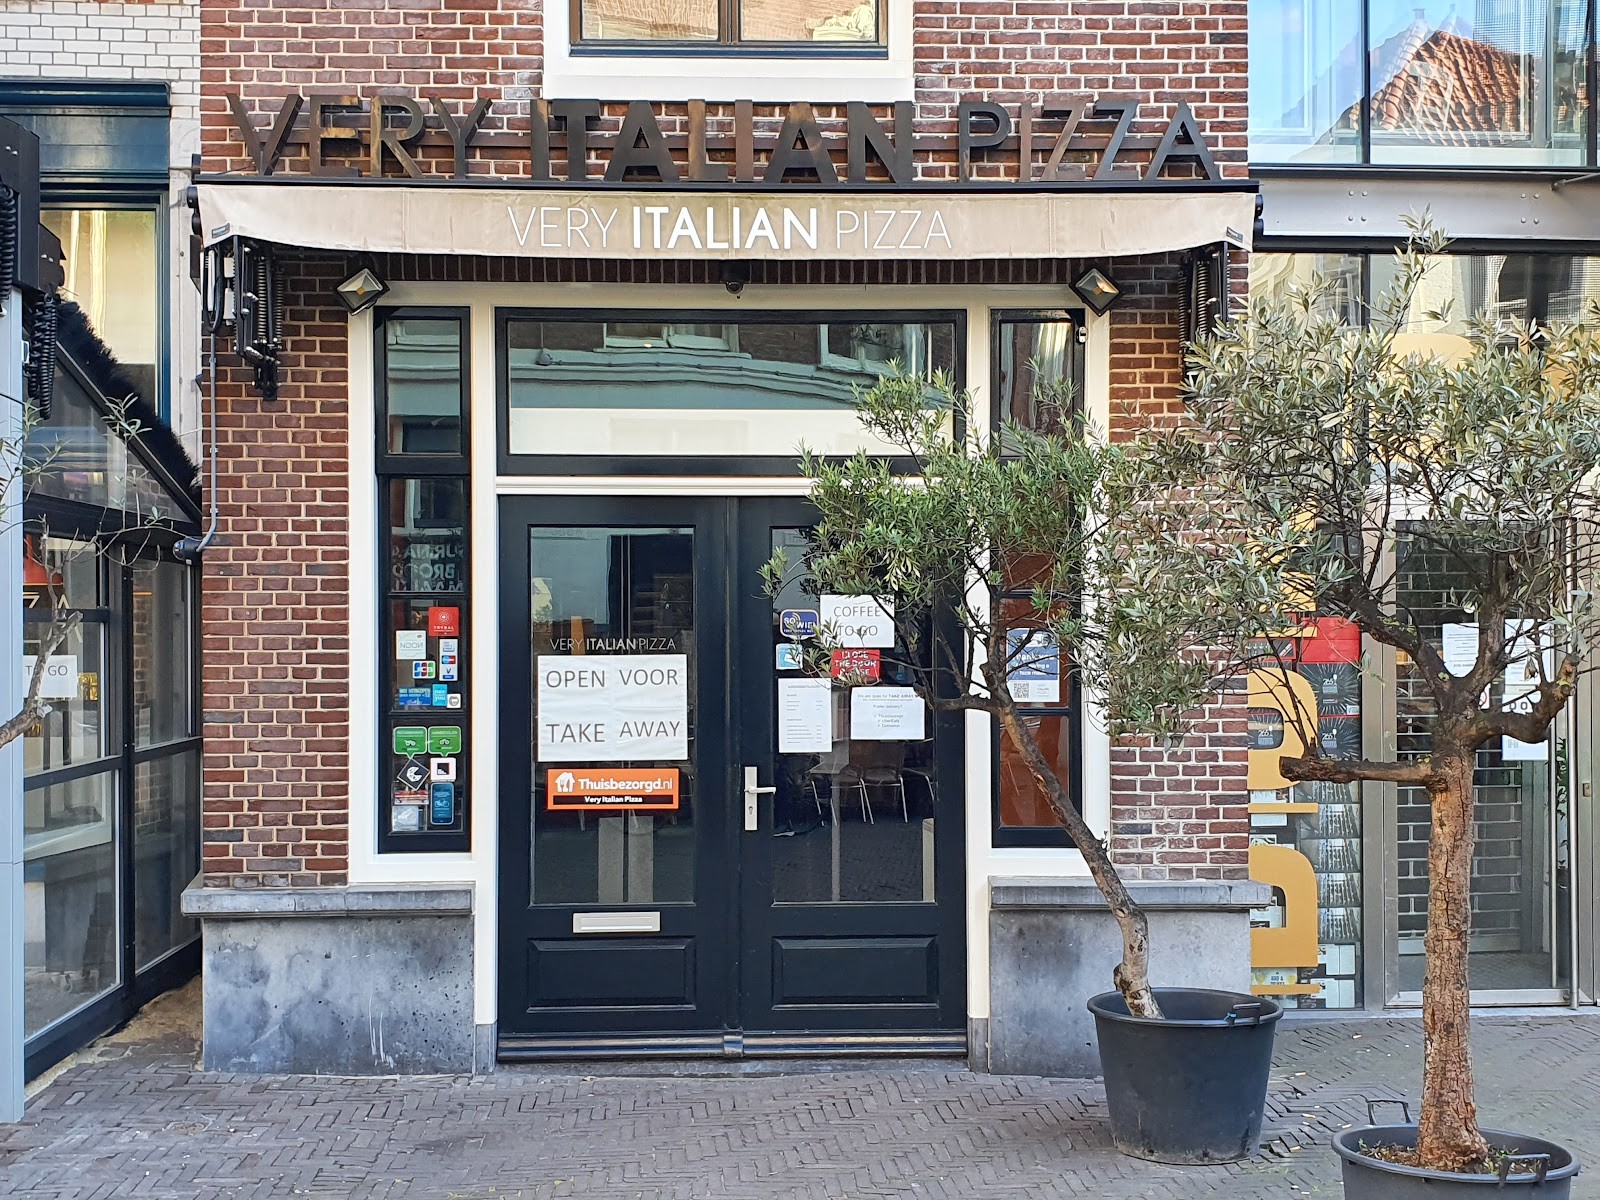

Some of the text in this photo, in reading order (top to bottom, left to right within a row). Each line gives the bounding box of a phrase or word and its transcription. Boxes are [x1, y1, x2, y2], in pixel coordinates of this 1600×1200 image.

[226, 93, 1221, 183] VERY ITALIAN PIZZA
[506, 205, 953, 250] VERY ITALIAN PIZZA
[833, 605, 881, 618] COFFEE
[837, 624, 854, 637] TO
[549, 637, 676, 650] VERY ITALIAN PIZZA
[47, 665, 69, 677] GO
[546, 669, 679, 688] OPEN VOOR
[546, 721, 680, 743] TAKE AWAY
[577, 777, 673, 793] Thuisbezorgd.nl
[584, 795, 643, 805] Very Italian Pizza
